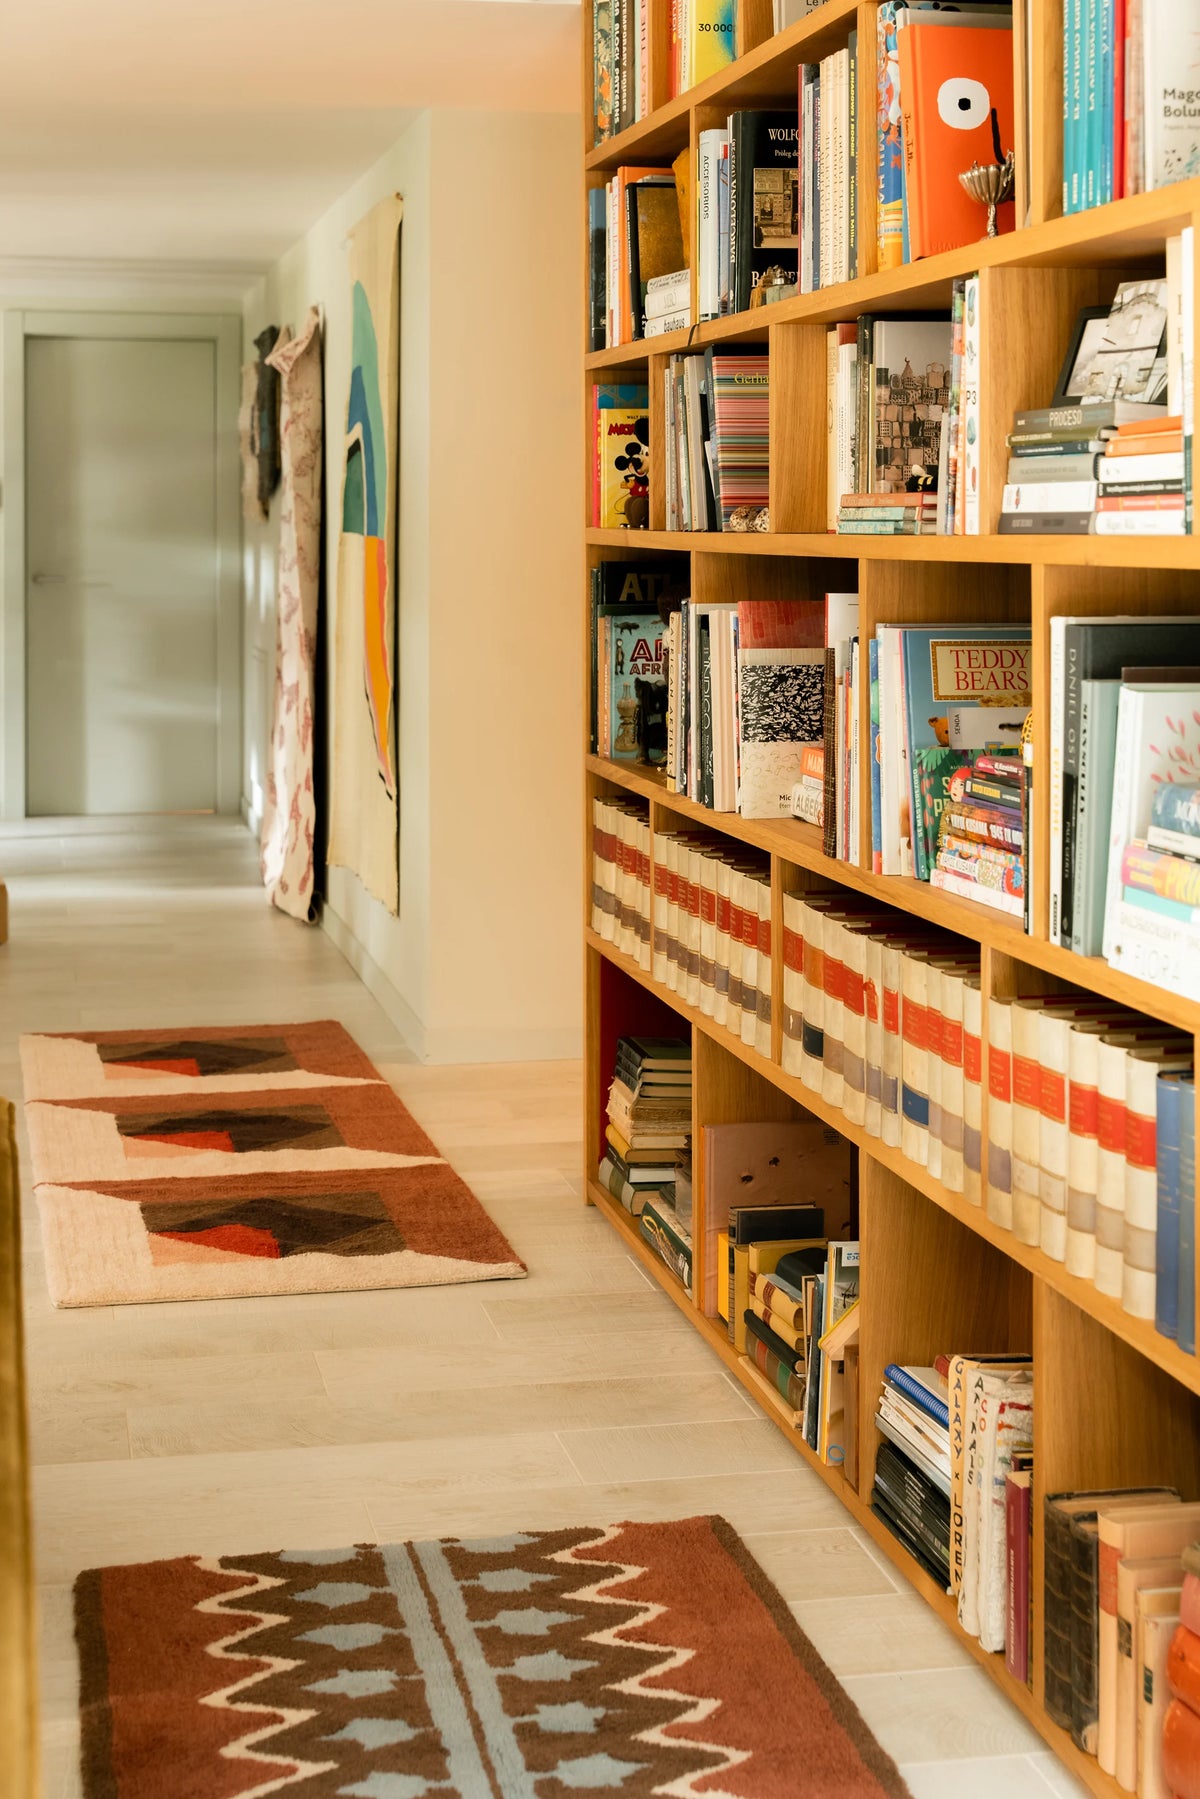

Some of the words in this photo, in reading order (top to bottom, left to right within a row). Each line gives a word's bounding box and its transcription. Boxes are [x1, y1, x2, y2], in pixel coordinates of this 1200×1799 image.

[698, 23, 711, 33] 30
[713, 23, 733, 33] 000
[1073, 103, 1080, 120] EL
[1088, 92, 1095, 111] LA
[664, 317, 685, 333] bauhaus
[1049, 409, 1083, 428] PROCESO
[629, 663, 666, 675] AFRI
[949, 649, 1029, 669] TEDDY
[954, 670, 1029, 691] BEARS
[1068, 648, 1077, 717] DANIEL
[1068, 728, 1076, 766] OST
[912, 768, 920, 807] PEREZOSO
[795, 794, 820, 816] ALBER
[953, 1361, 964, 1459] GALAXY
[953, 1492, 963, 1594] LOREN
